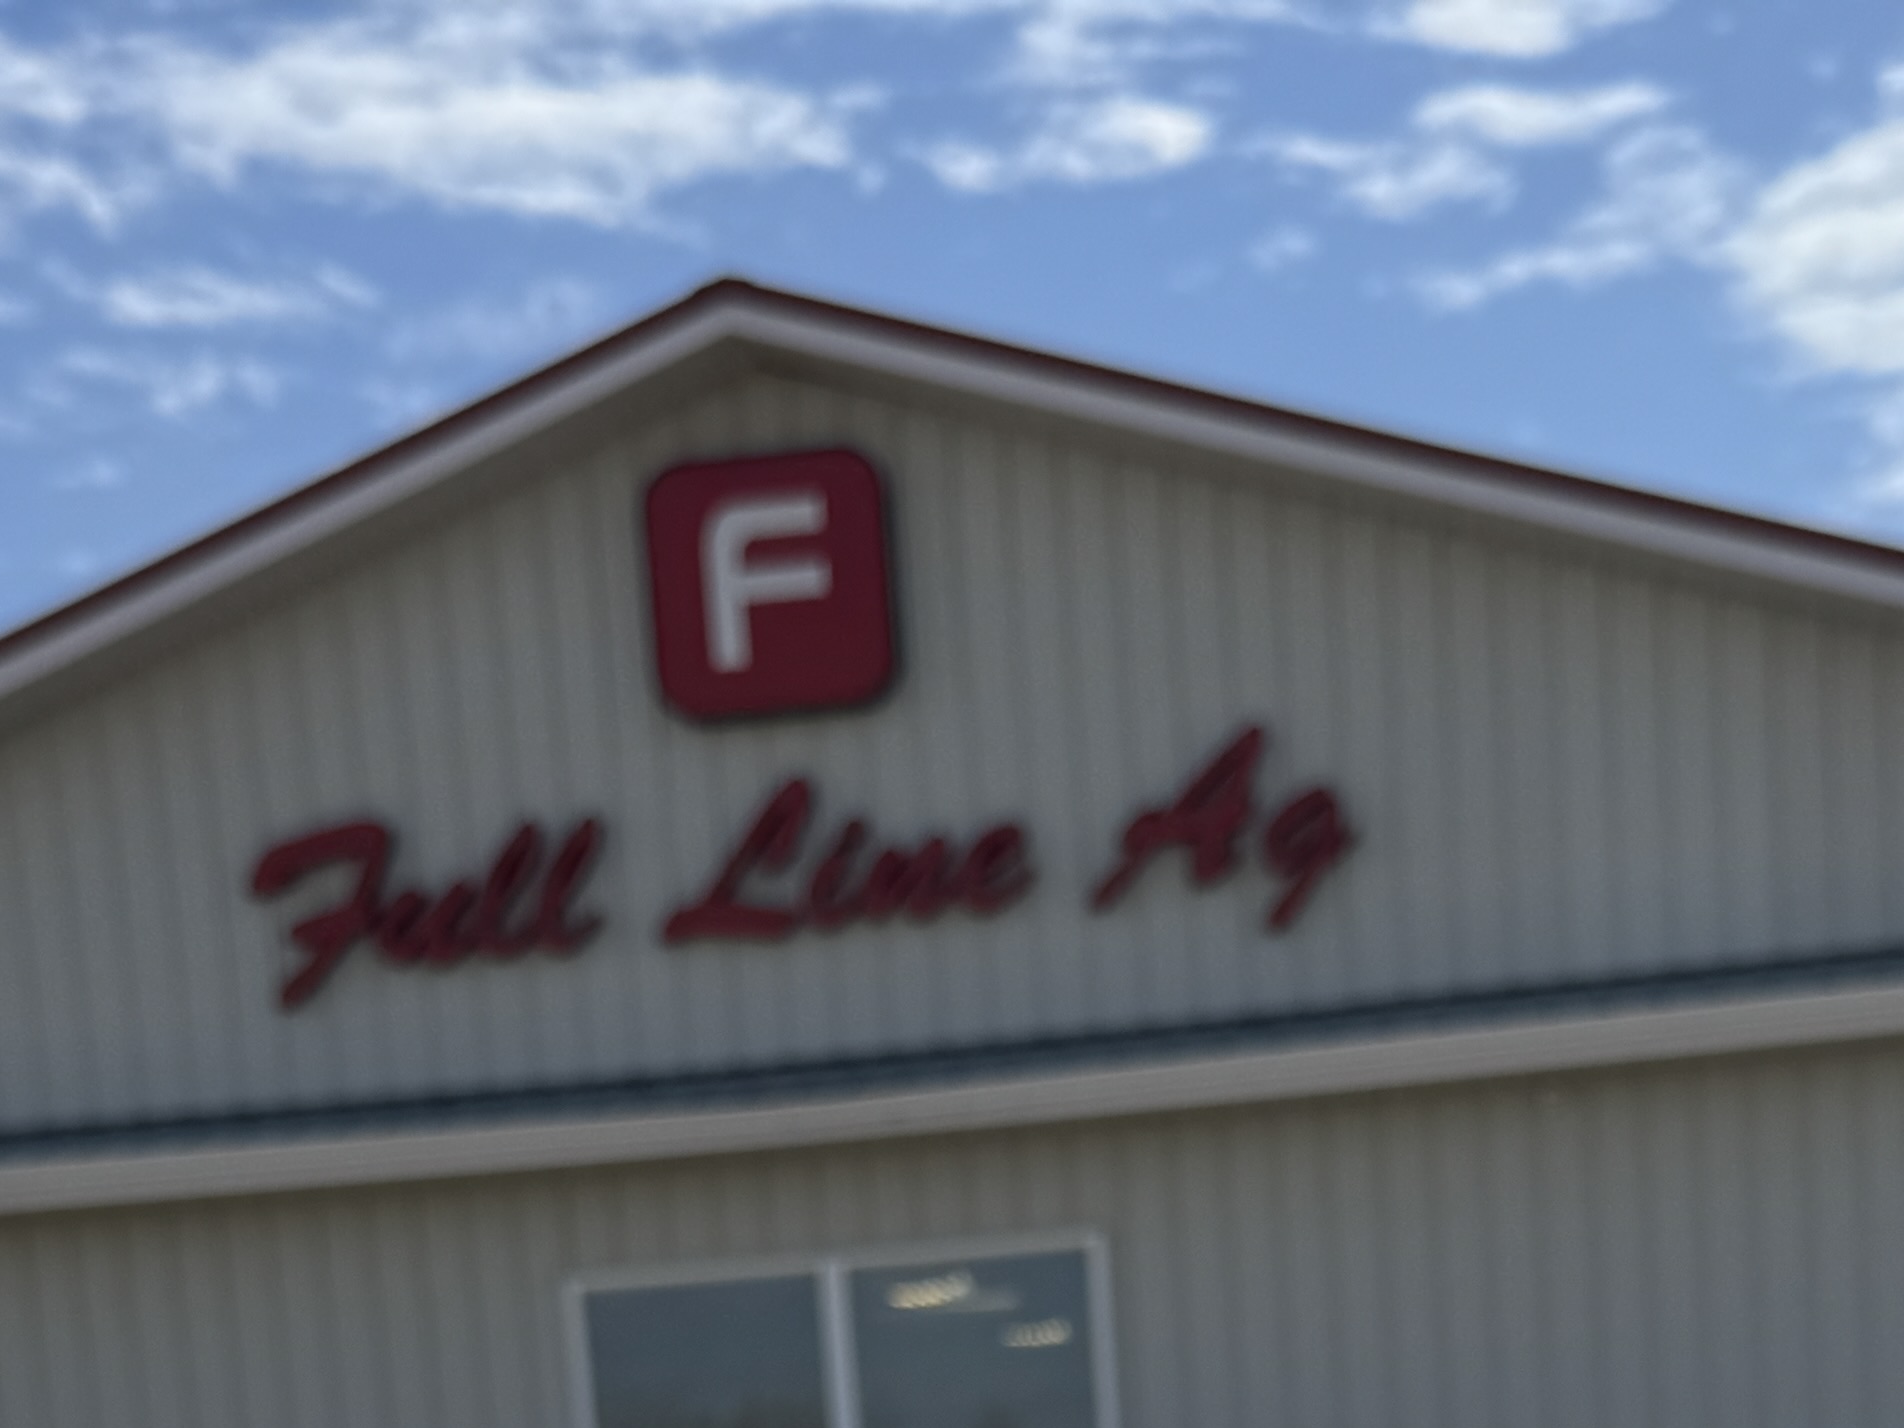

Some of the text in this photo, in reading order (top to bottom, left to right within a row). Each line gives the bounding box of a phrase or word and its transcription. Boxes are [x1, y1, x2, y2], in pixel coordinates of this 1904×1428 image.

[704, 490, 834, 675] F
[251, 725, 1358, 1012] Full Line Ag
